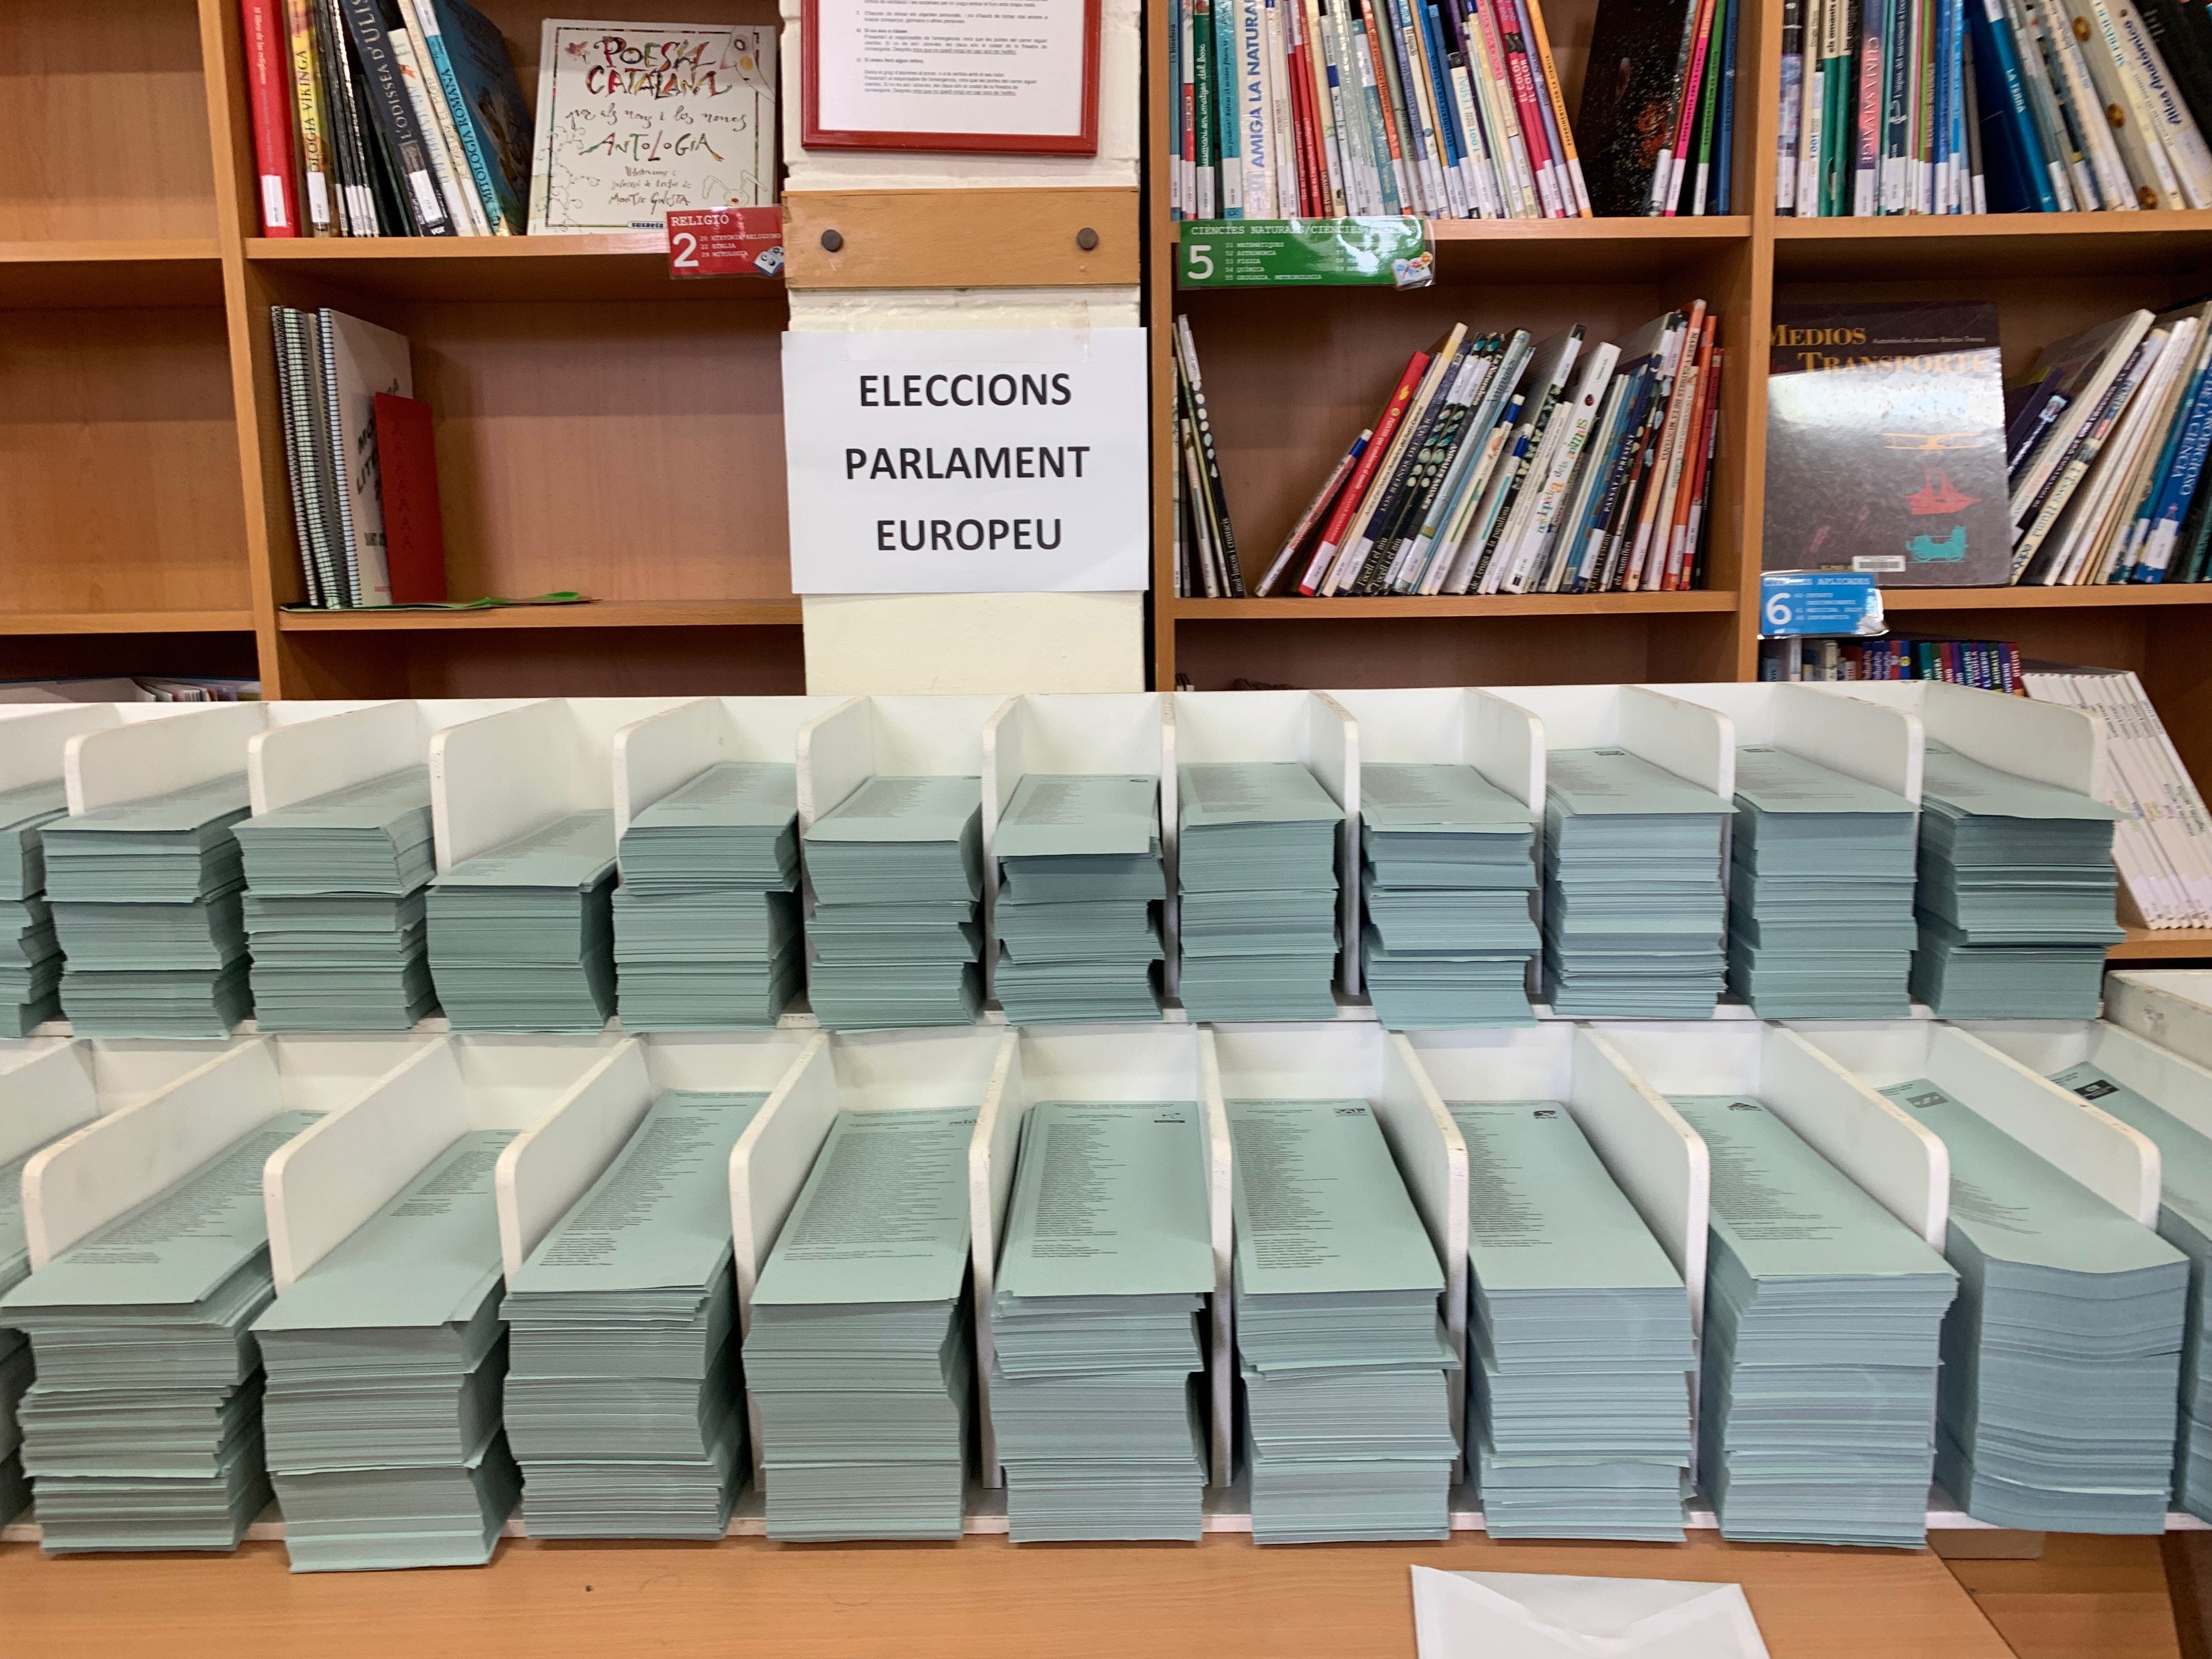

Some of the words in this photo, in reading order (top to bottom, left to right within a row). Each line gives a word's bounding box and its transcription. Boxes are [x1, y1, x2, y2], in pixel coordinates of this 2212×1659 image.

[1244, 0, 1260, 76] NATURA
[296, 51, 312, 111] VIKINGA
[1511, 59, 1525, 88] COLOR
[1521, 59, 1534, 88] COLOR
[378, 63, 412, 140] L'ODISSEA
[442, 67, 469, 127] ROMANA
[1249, 80, 1262, 105] LA
[1519, 91, 1527, 102] EL
[1528, 92, 1537, 103] EL
[2159, 90, 2182, 126] Atlas
[1200, 129, 1209, 166] iccionari
[1251, 111, 1265, 168] AMIGA
[462, 130, 495, 204] MITOLOGIA
[672, 232, 699, 267] 2
[1187, 245, 1214, 279] 5
[1771, 324, 1866, 346] MEDIOS
[860, 374, 1071, 407] ELECCIONS
[845, 447, 1090, 479] PARLAMENT
[877, 519, 1061, 550] EUROPEU
[1766, 592, 1792, 625] 6
[1980, 652, 1990, 677] CUERPO
[1989, 650, 2001, 684] ANIMALES
[2003, 663, 2013, 693] NVIERNO
[2010, 650, 2021, 677] OFICIOS
